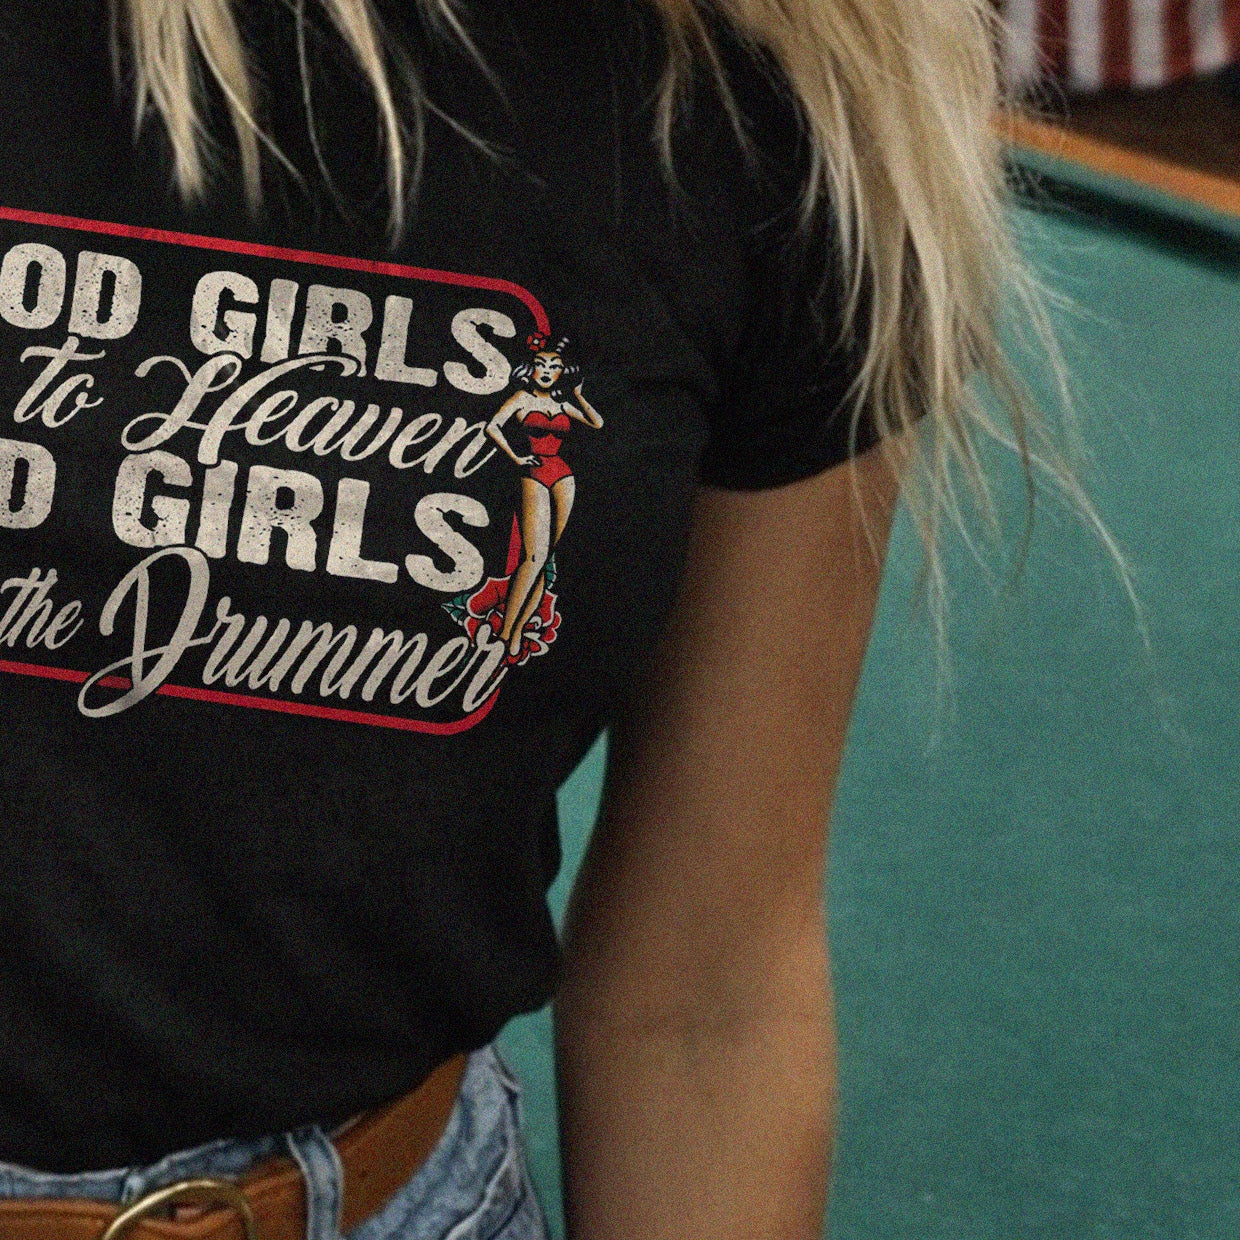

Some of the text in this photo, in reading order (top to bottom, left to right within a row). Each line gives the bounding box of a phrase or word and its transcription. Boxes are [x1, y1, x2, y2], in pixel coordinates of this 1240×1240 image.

[189, 270, 516, 395] GIRLS
[12, 335, 106, 429] to
[120, 352, 498, 479] Heaven
[111, 450, 492, 593] GIRLS
[77, 545, 511, 720] Drummer
